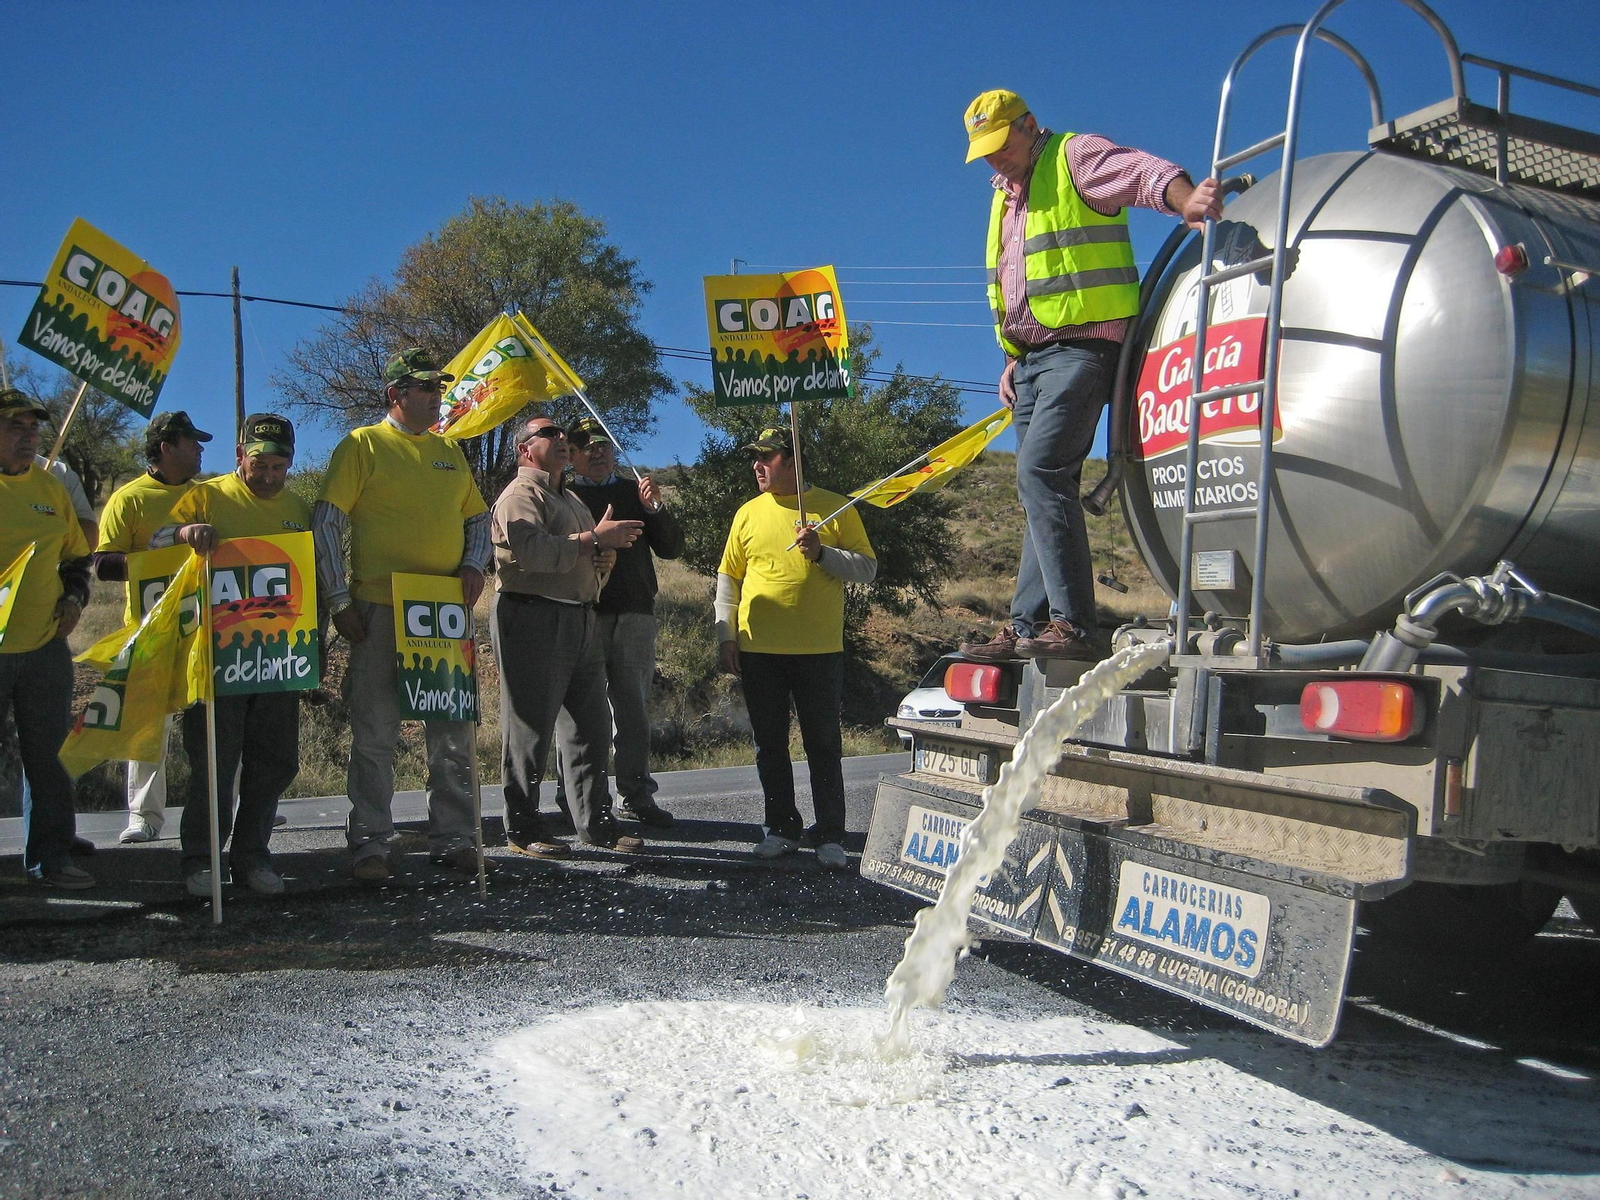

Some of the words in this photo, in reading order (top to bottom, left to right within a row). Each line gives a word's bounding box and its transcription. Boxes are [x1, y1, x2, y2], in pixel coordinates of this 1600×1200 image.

[57, 279, 101, 311] ANDALUCIA
[66, 254, 174, 339] COAG
[719, 293, 834, 332] COAG
[719, 333, 764, 342] ANDALUCIA
[33, 312, 82, 365] Vamos
[79, 348, 104, 374] por
[101, 358, 154, 406] delante
[1158, 335, 1242, 393] Gacía
[719, 368, 771, 398] Vamos
[773, 375, 800, 401] por
[803, 360, 850, 391] delante
[1152, 456, 1245, 485] PRODCTOS
[143, 566, 287, 614] CAG
[406, 639, 452, 648] ANDALUCIA
[224, 645, 312, 683] delante
[405, 678, 457, 714] Vamos
[459, 689, 475, 719] por
[923, 743, 957, 773] 8725
[961, 749, 981, 777] GL
[922, 812, 966, 840] CARROCE
[904, 832, 960, 869] ALAM
[926, 876, 945, 893] LUC
[1142, 871, 1243, 920] CARROCERIAS
[1117, 895, 1258, 970] ALAMOS
[1077, 930, 1099, 951] 957
[1100, 937, 1116, 957] 51
[1117, 942, 1136, 962] 48
[1136, 948, 1155, 968] 88
[1157, 956, 1218, 992] LUCENA
